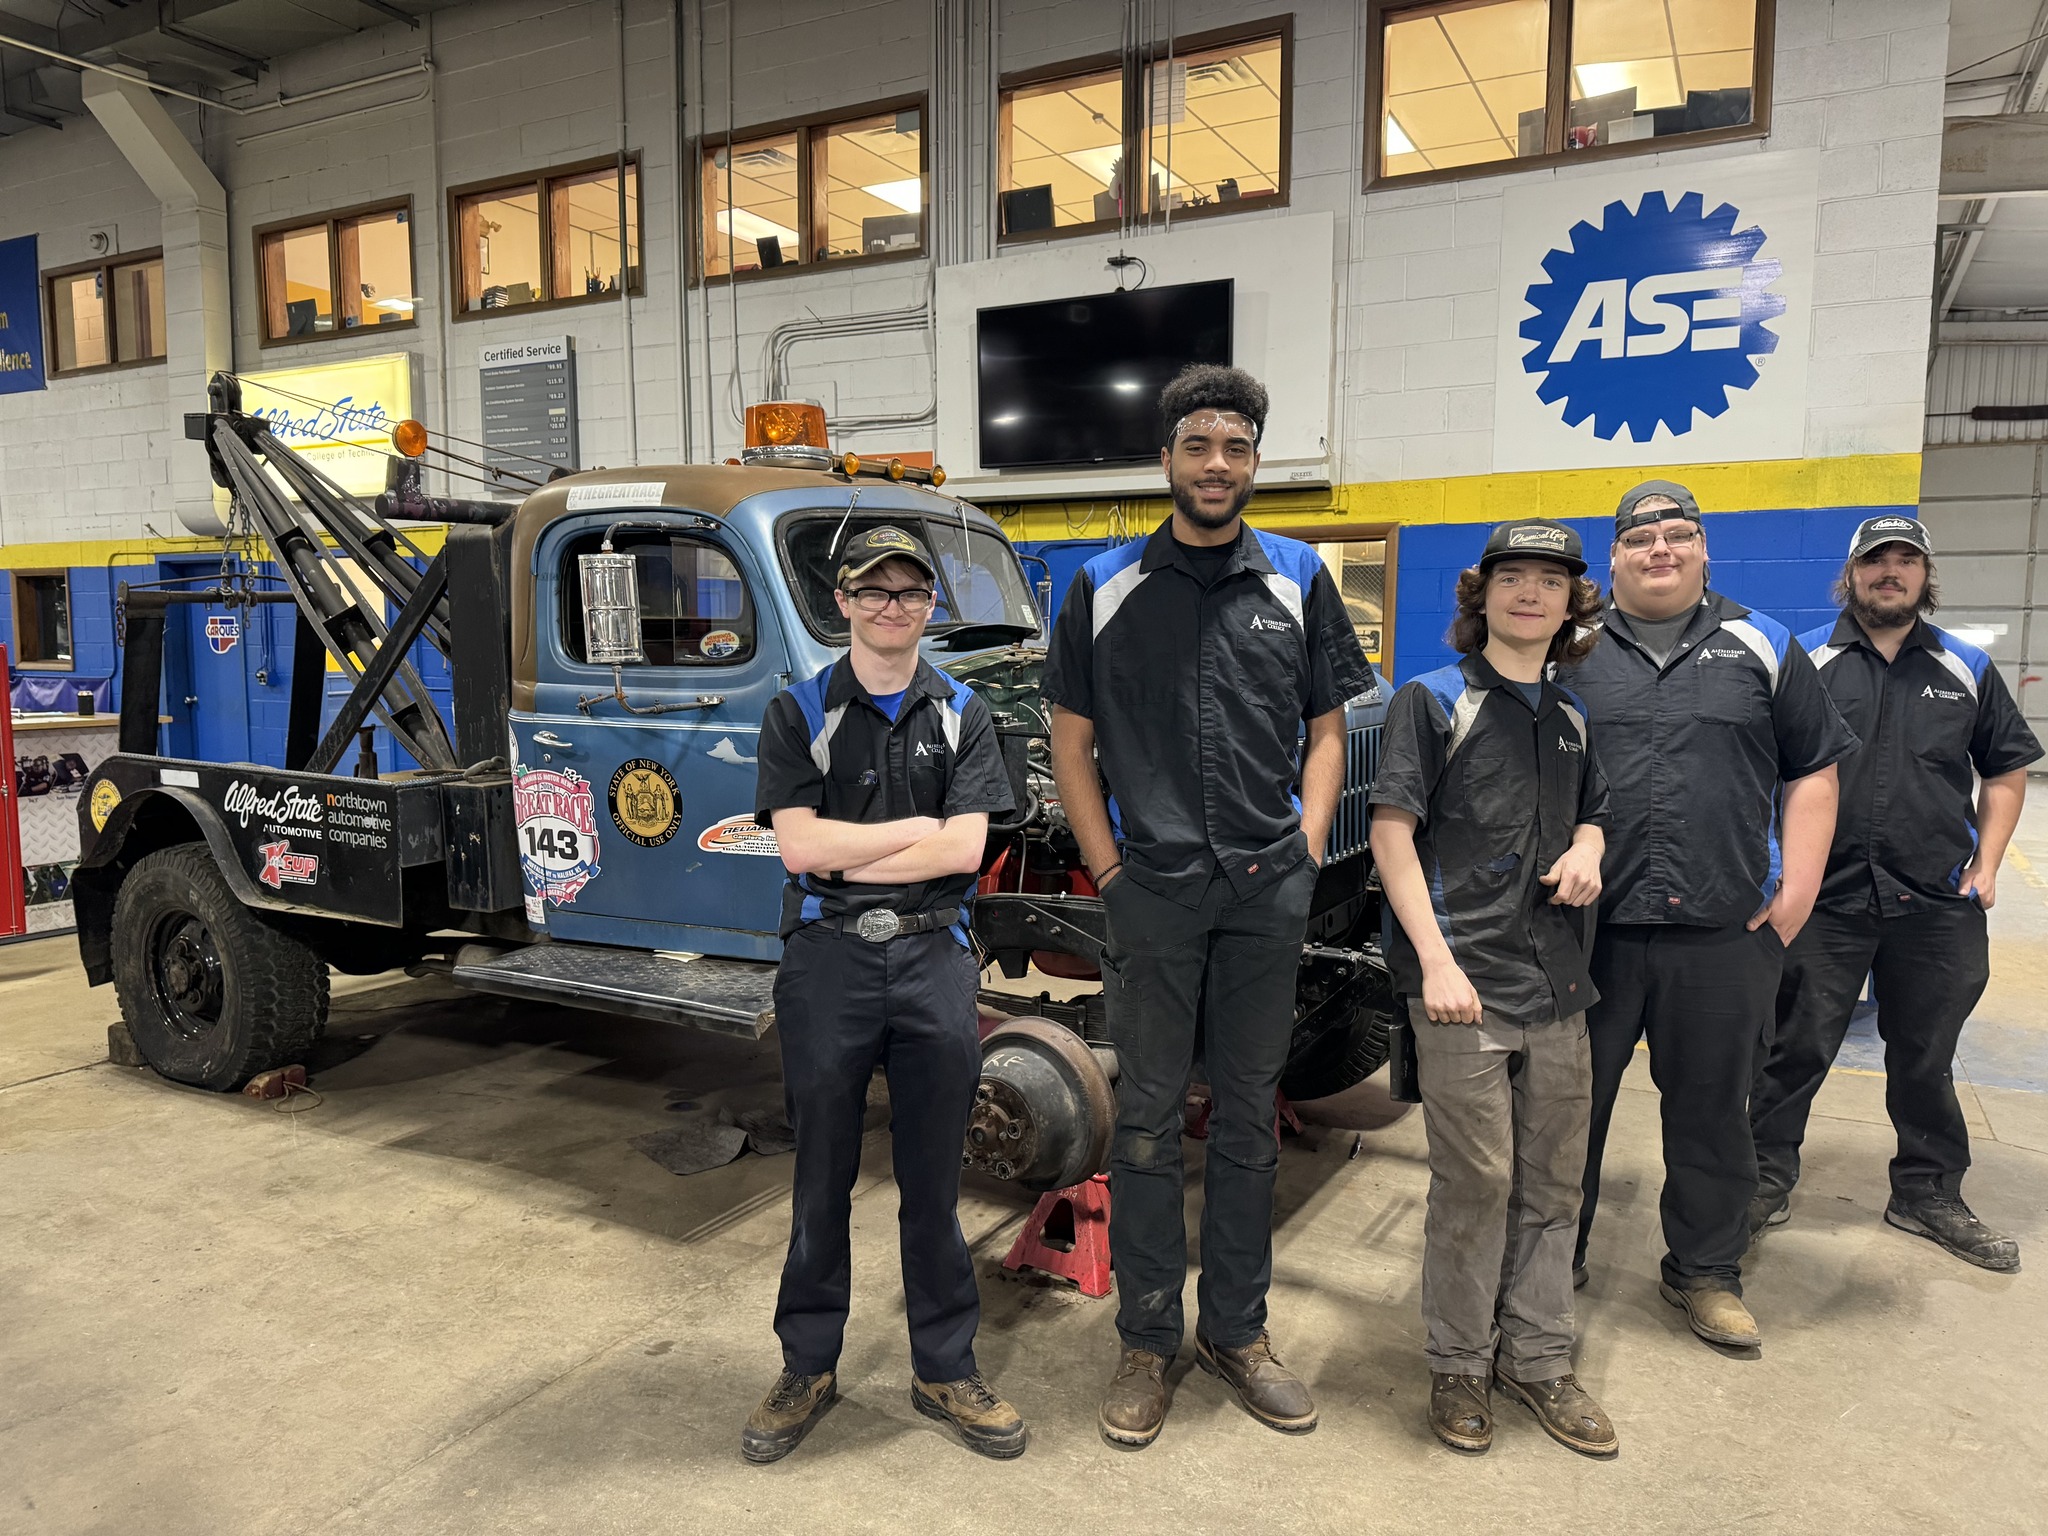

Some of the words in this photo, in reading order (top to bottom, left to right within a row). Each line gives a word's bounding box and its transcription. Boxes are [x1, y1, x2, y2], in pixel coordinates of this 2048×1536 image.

[1546, 266, 1744, 364] ASE
[484, 347, 524, 362] Certified
[526, 343, 562, 358] Service
[320, 396, 389, 441] State
[307, 452, 335, 462] College
[337, 451, 345, 459] of
[1510, 530, 1550, 546] Chemical
[206, 625, 240, 638] CARQUES
[608, 768, 625, 798] STATE
[625, 760, 637, 772] OF
[639, 759, 659, 771] NEW
[660, 767, 680, 797] YORK
[224, 780, 280, 828] Alfred
[277, 785, 324, 824] State
[326, 791, 388, 814] northtown
[514, 790, 552, 827] GREAT
[553, 793, 594, 835] RACE
[263, 824, 323, 840] AUTOMOTIVE
[328, 810, 392, 833] automotive
[612, 812, 647, 847] OFFICIAL
[649, 834, 666, 847] USE
[665, 811, 682, 838] ONLY
[328, 827, 388, 849] companies
[525, 826, 579, 861] 143
